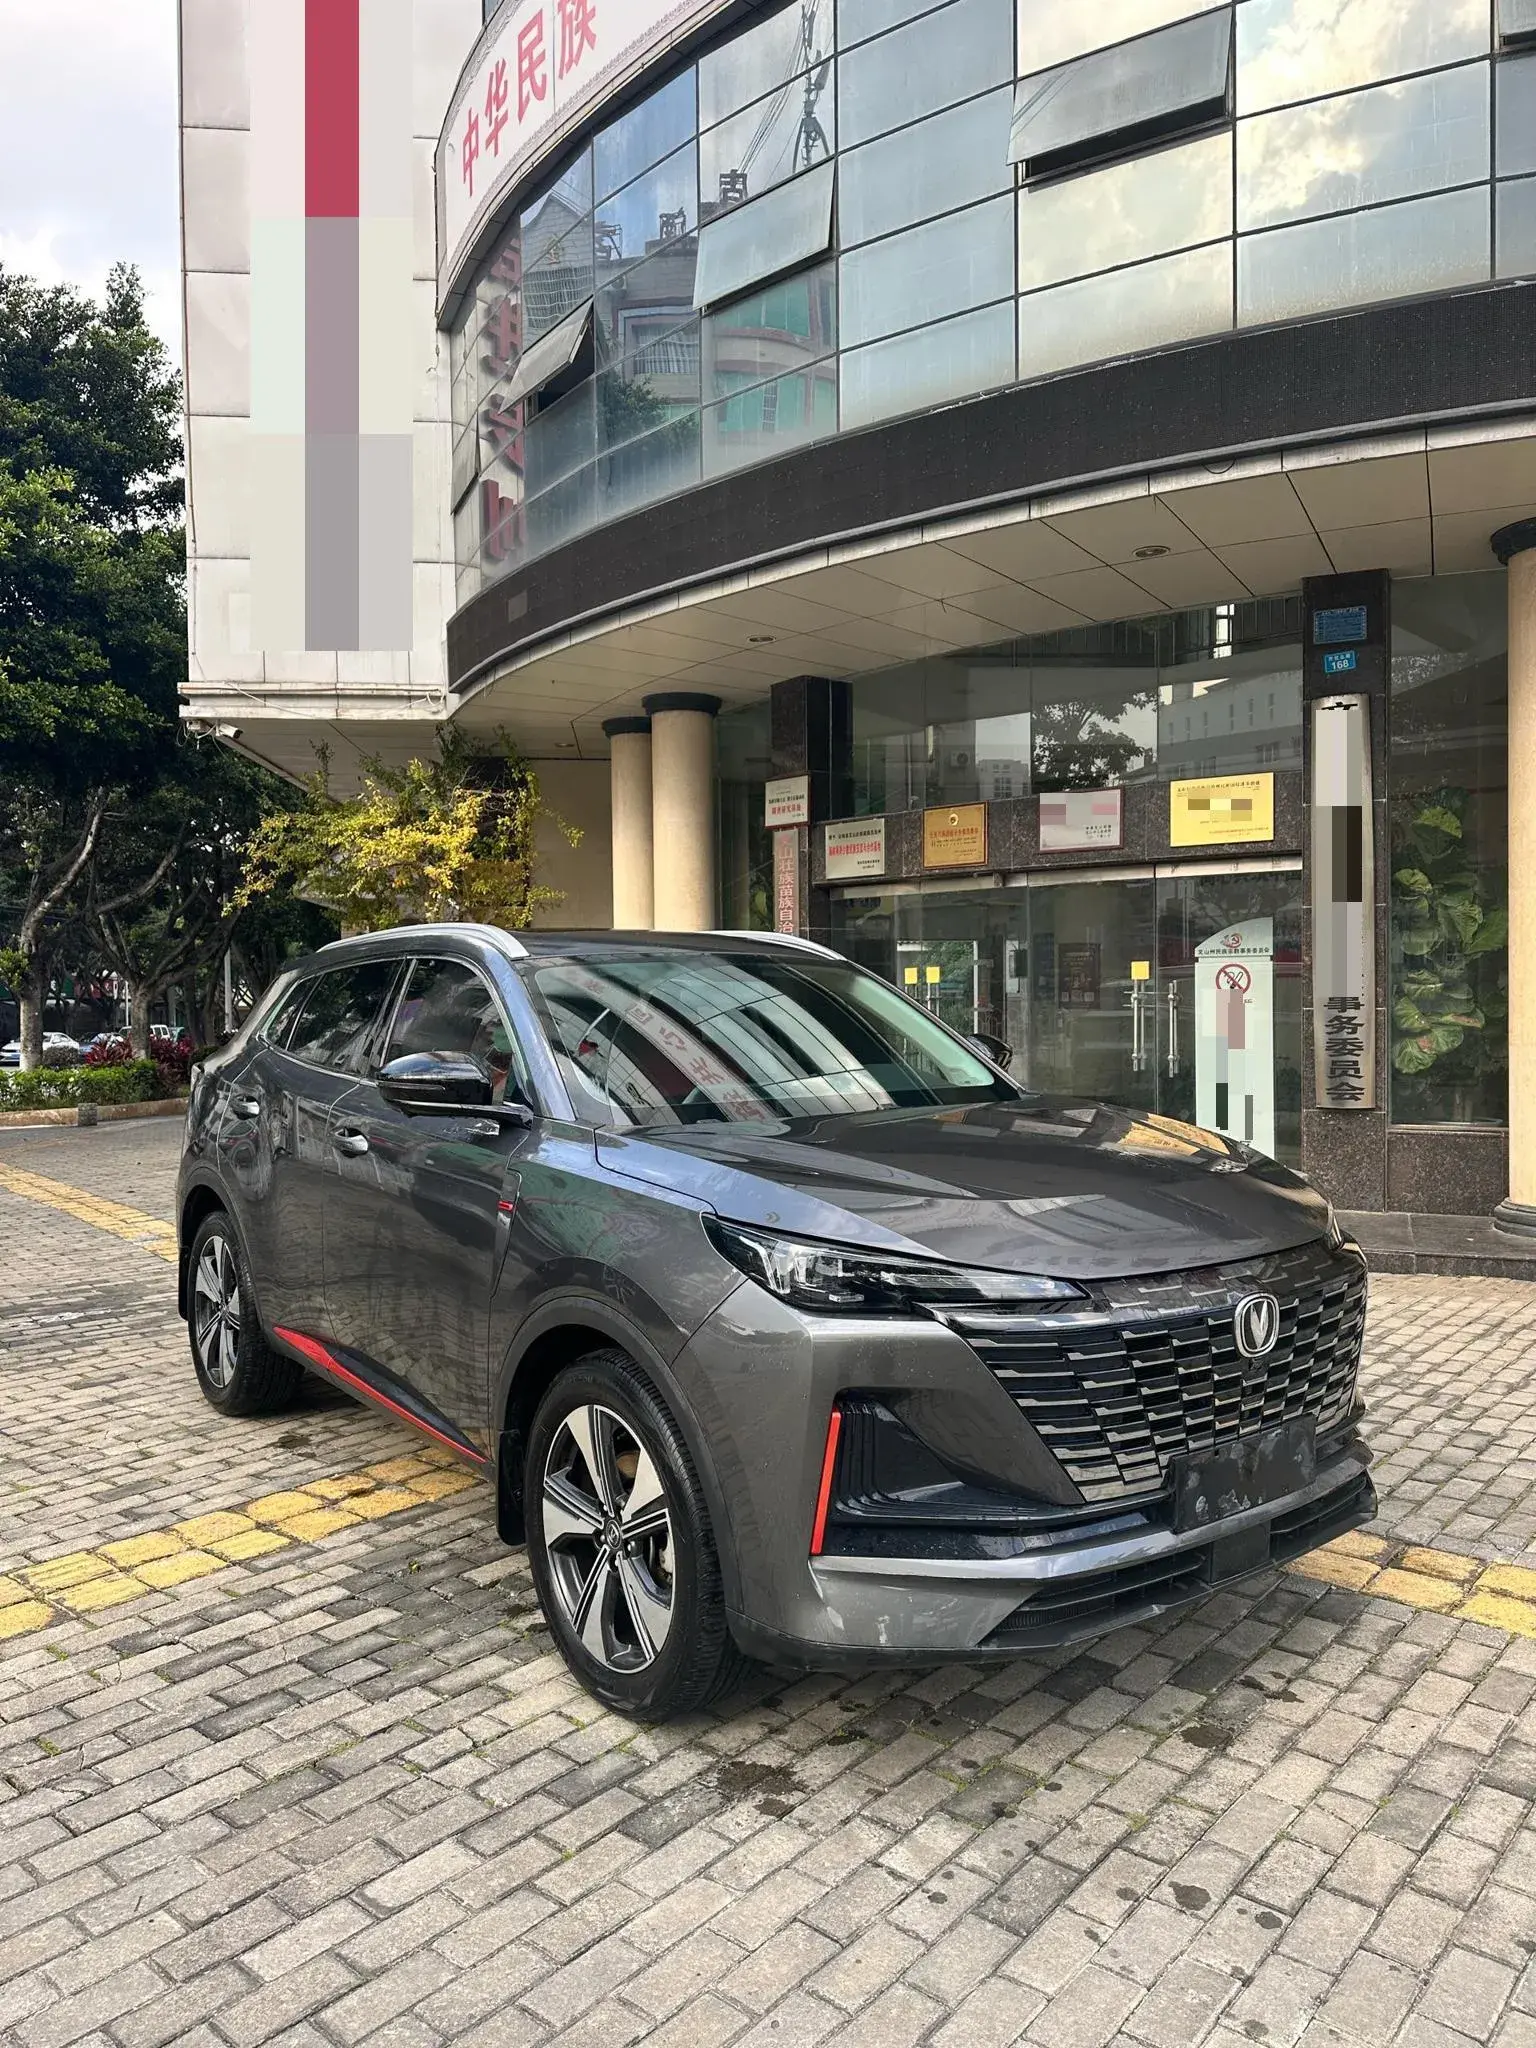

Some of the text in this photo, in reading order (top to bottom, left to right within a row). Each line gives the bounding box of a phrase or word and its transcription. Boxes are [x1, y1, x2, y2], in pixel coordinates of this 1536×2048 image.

[463, 0, 597, 197] 中华民族
[1331, 659, 1350, 670] 168
